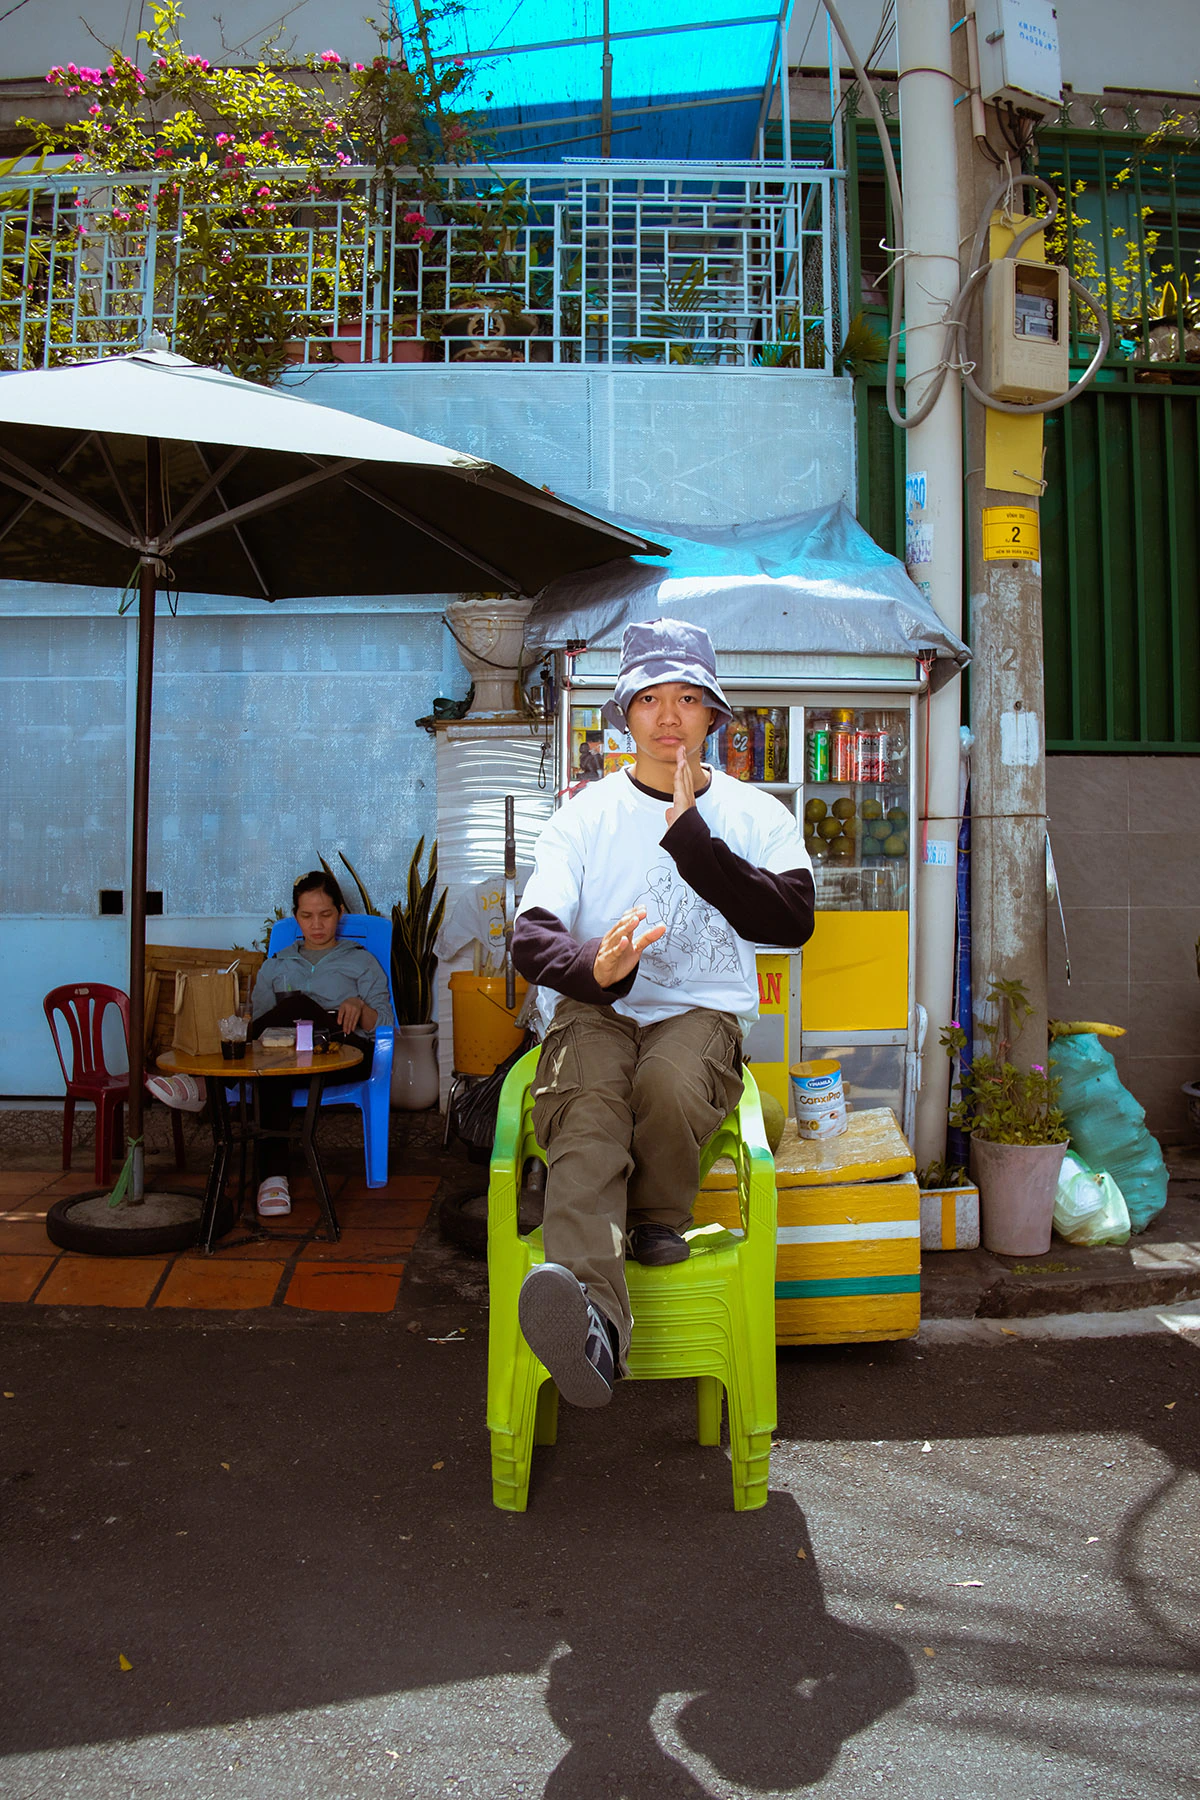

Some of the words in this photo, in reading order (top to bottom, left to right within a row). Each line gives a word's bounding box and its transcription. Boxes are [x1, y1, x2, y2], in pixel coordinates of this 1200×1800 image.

[1011, 526, 1021, 543] 2
[732, 733, 749, 752] C2
[799, 1091, 841, 1105] CanxiPro
